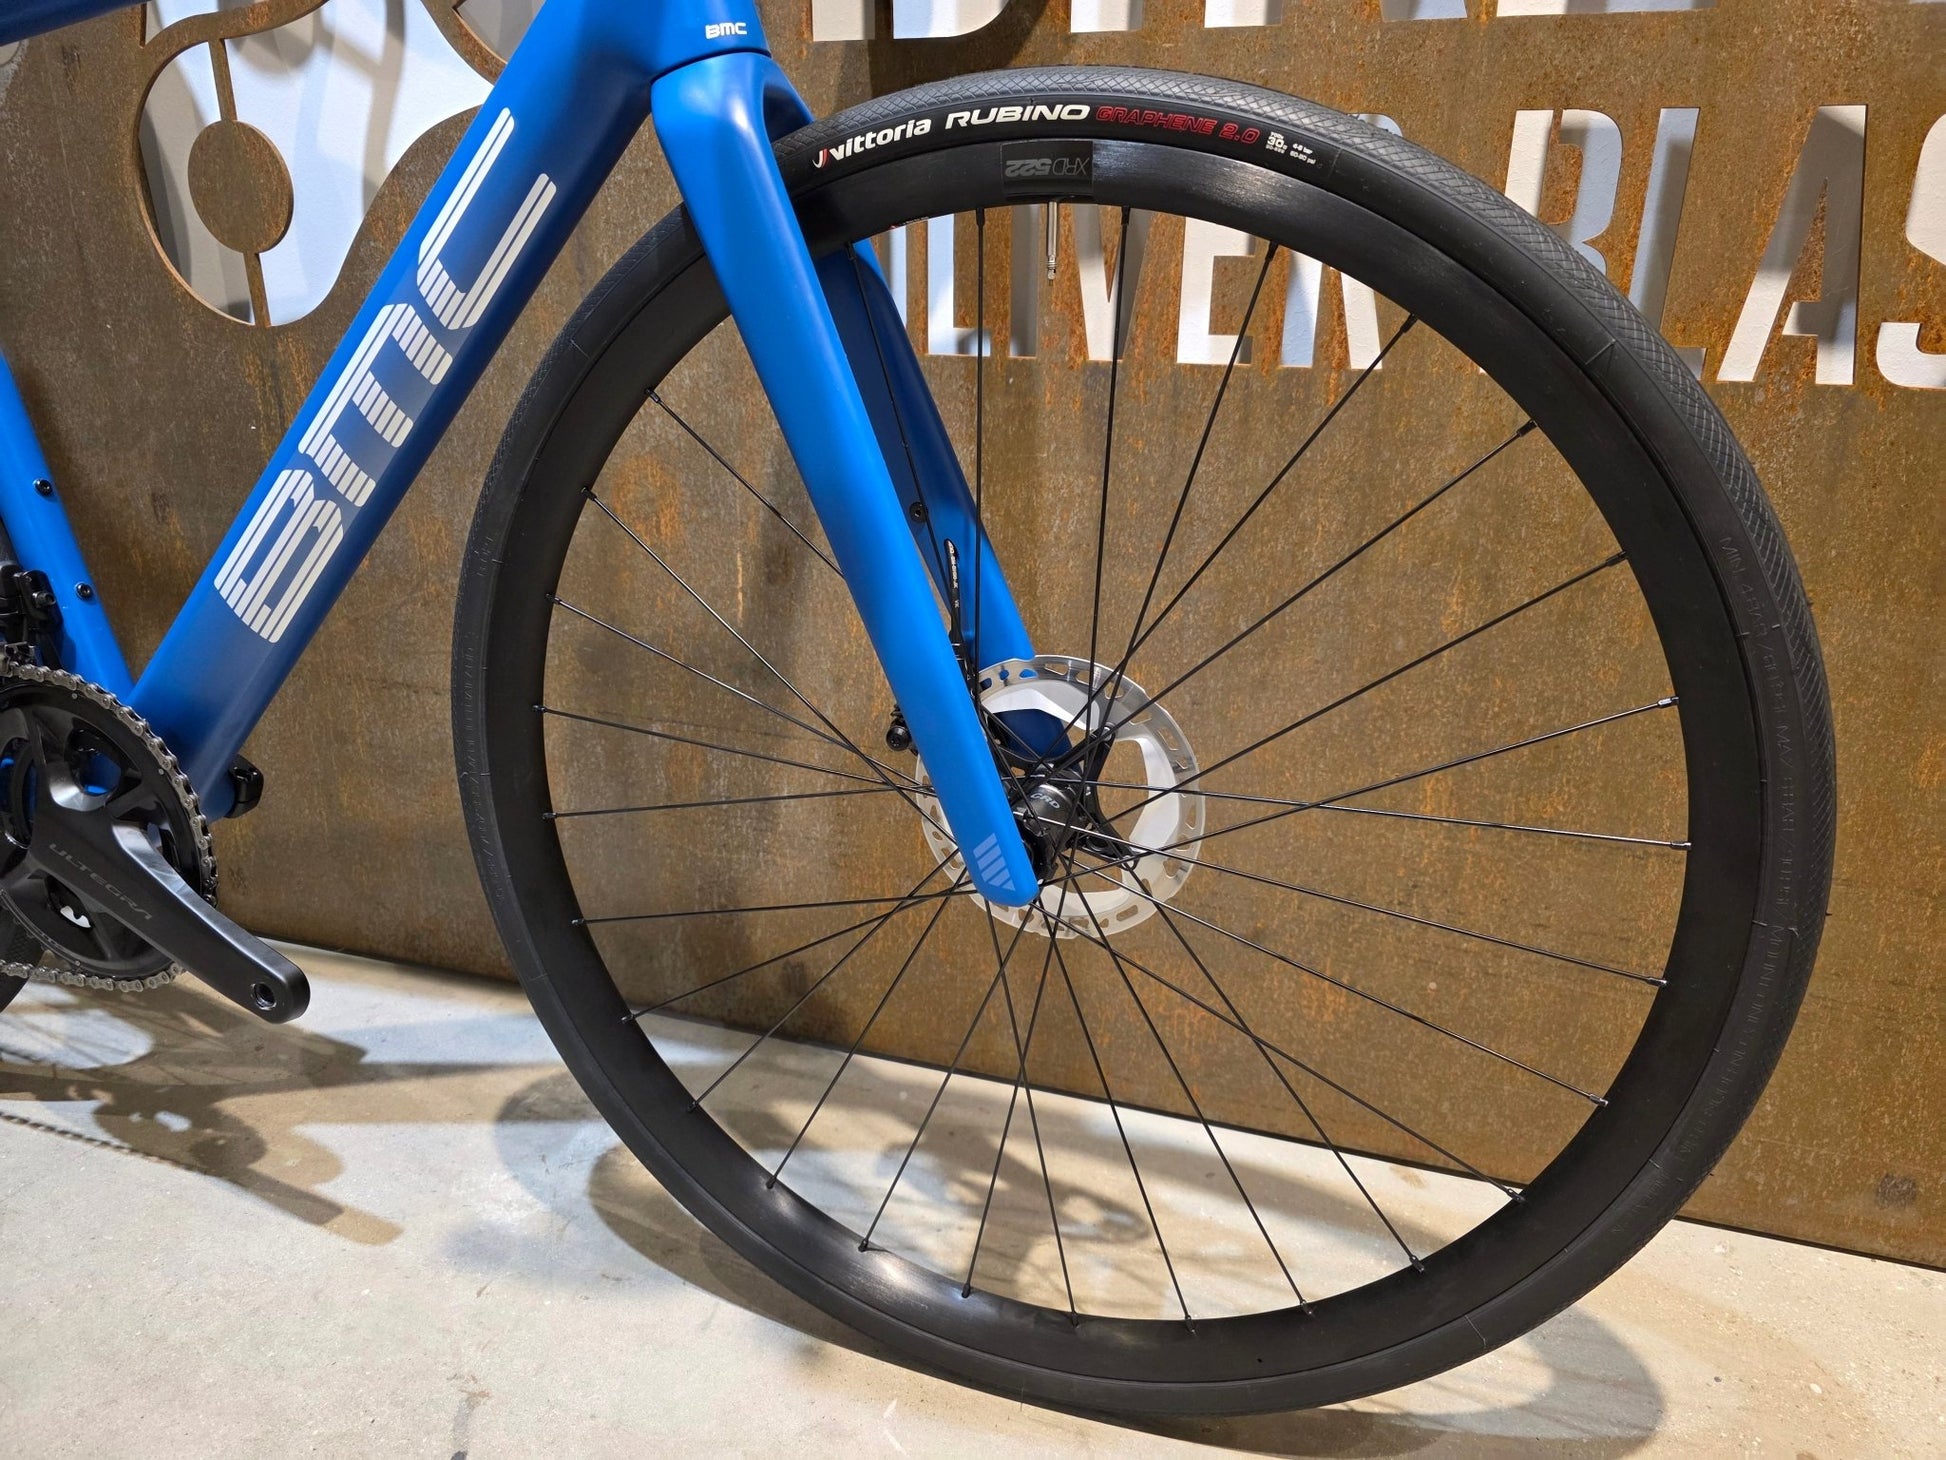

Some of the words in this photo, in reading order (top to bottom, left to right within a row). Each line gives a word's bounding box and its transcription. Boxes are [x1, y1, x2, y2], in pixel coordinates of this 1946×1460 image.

[705, 22, 747, 39] BMC
[829, 119, 932, 161] vittoria
[945, 104, 1090, 130] RUBINO
[1096, 106, 1218, 134] GRAPHENE
[1219, 123, 1260, 144] 2.0
[214, 107, 557, 643] BMC
[48, 843, 153, 920] ULTEGRA
